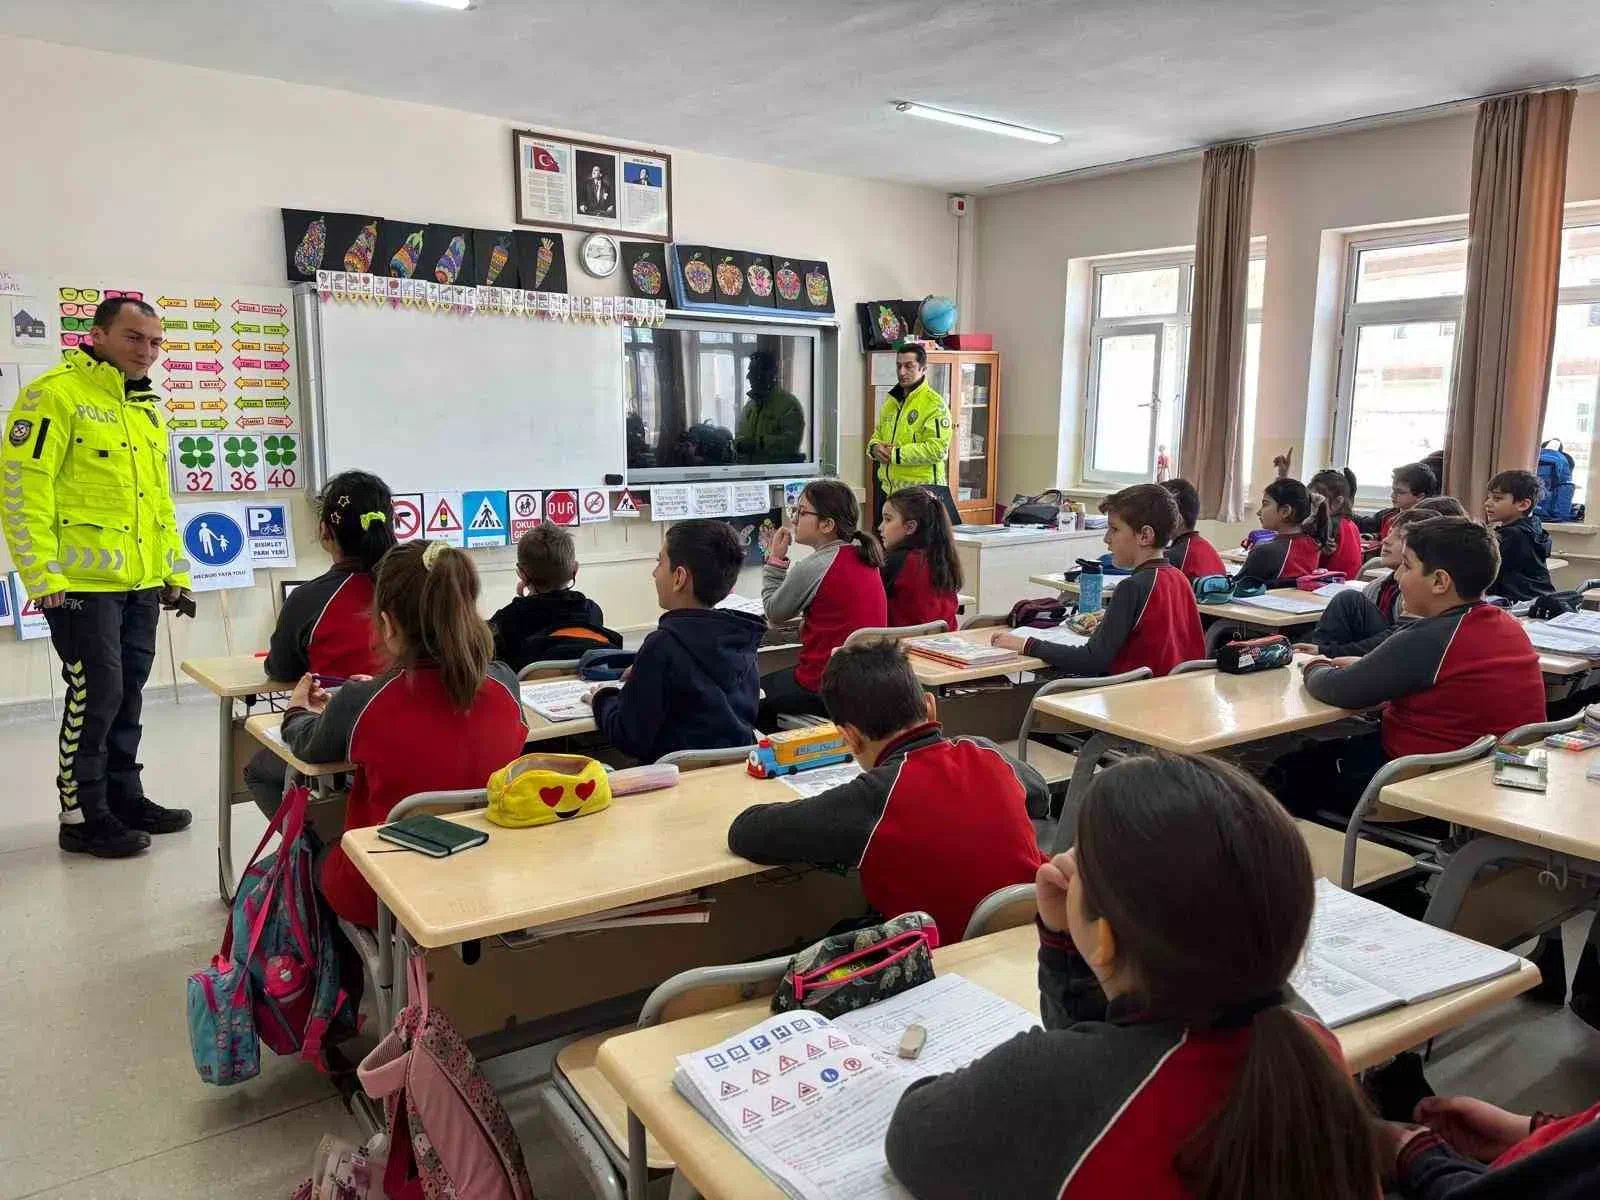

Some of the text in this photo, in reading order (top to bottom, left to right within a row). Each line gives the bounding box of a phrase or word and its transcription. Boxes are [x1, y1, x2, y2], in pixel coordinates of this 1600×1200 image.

[186, 471, 214, 491] 32
[230, 471, 257, 491] 36
[267, 469, 296, 488] 40
[548, 501, 575, 515] DUR
[249, 508, 273, 531] P
[515, 520, 536, 529] OKUL
[513, 530, 529, 538] GE
